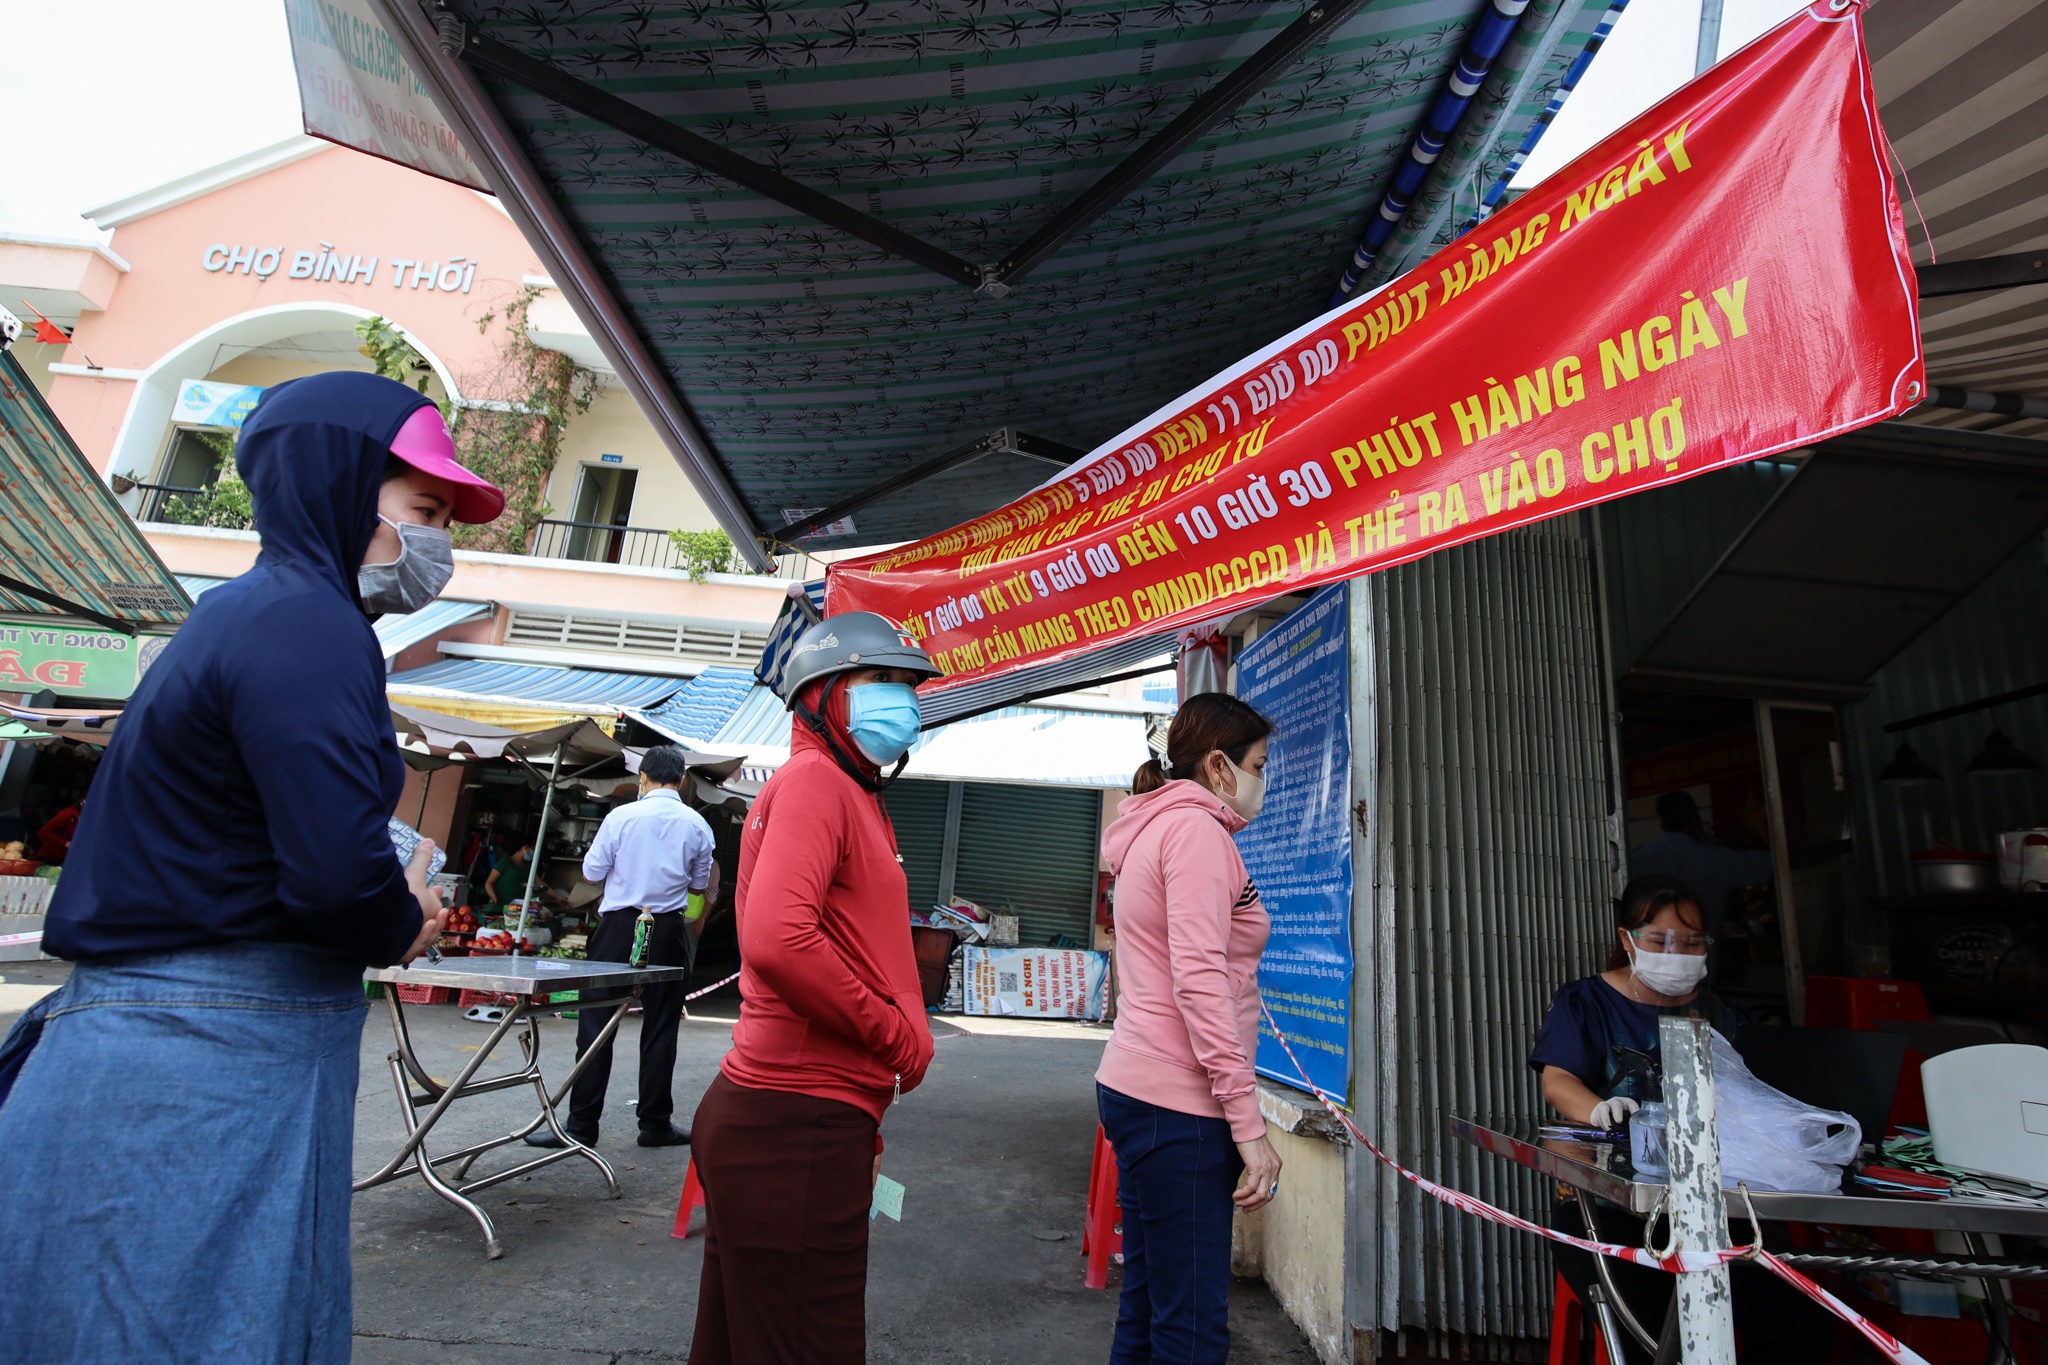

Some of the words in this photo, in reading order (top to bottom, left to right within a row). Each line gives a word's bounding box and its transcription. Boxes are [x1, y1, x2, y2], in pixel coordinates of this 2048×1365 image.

[202, 243, 284, 282] CHỢ
[288, 240, 379, 285] BÌNH
[390, 256, 478, 294] THỚI
[1043, 482, 1074, 514] TỪ
[1069, 478, 1090, 503] 5
[1086, 456, 1126, 496] GIỜ
[1122, 442, 1157, 477] 00
[1152, 414, 1208, 462] ĐẾN
[1206, 394, 1240, 434] 11
[1244, 360, 1296, 416] GIỜ
[1298, 338, 1339, 386] 00
[1340, 282, 1430, 364] PHÚT
[1439, 212, 1551, 306] HÀNG
[1558, 119, 1695, 232] NGÀY
[924, 610, 936, 636] 7
[935, 596, 962, 632] GIỜ
[960, 594, 984, 622] 00
[980, 580, 1010, 615] VÀ
[1004, 570, 1033, 606] TỪ
[1030, 569, 1050, 598] 9
[1046, 548, 1087, 592] GIỜ
[1084, 542, 1122, 578] 00
[1116, 515, 1178, 567] ĐẾN
[1174, 505, 1218, 545] 10
[1216, 473, 1279, 530] GIỜ
[1279, 460, 1332, 508] 30
[1330, 413, 1443, 488] PHÚT
[1450, 356, 1586, 446] HÀNG
[1598, 276, 1749, 390] NGÀY
[959, 544, 998, 580] THỜI
[996, 527, 1049, 564] GIAN
[1045, 508, 1094, 546] CẤP
[1094, 482, 1142, 528] THẺ
[1138, 474, 1170, 508] ĐI
[1170, 440, 1232, 492] CHỢ
[1232, 416, 1277, 465] TỪ
[937, 652, 956, 677] ĐI
[952, 638, 986, 672] CHỢ
[984, 625, 1021, 664] CẦN
[1018, 613, 1078, 653] MANG
[1074, 596, 1130, 638] THEO
[1131, 544, 1288, 622] CMND/CCCD
[1294, 520, 1336, 574] VÀ
[1344, 490, 1406, 560] THẺ
[1418, 482, 1469, 538] RA
[1480, 448, 1566, 518] VÀO
[1580, 396, 1686, 483] CHỢ
[1278, 632, 1288, 647] ĐẶT
[1288, 624, 1300, 642] LỊCH
[1305, 612, 1316, 626] CHỢ
[1316, 603, 1330, 620] BÌNH
[643, 925, 651, 947] TEA
[1023, 958, 1033, 987] NGHỊ
[1061, 952, 1072, 974] KHUẨN
[1076, 952, 1085, 966] CHỢ
[1036, 979, 1047, 997] KHẨU
[1051, 980, 1060, 998] THÂN
[1078, 981, 1086, 992] KHI
